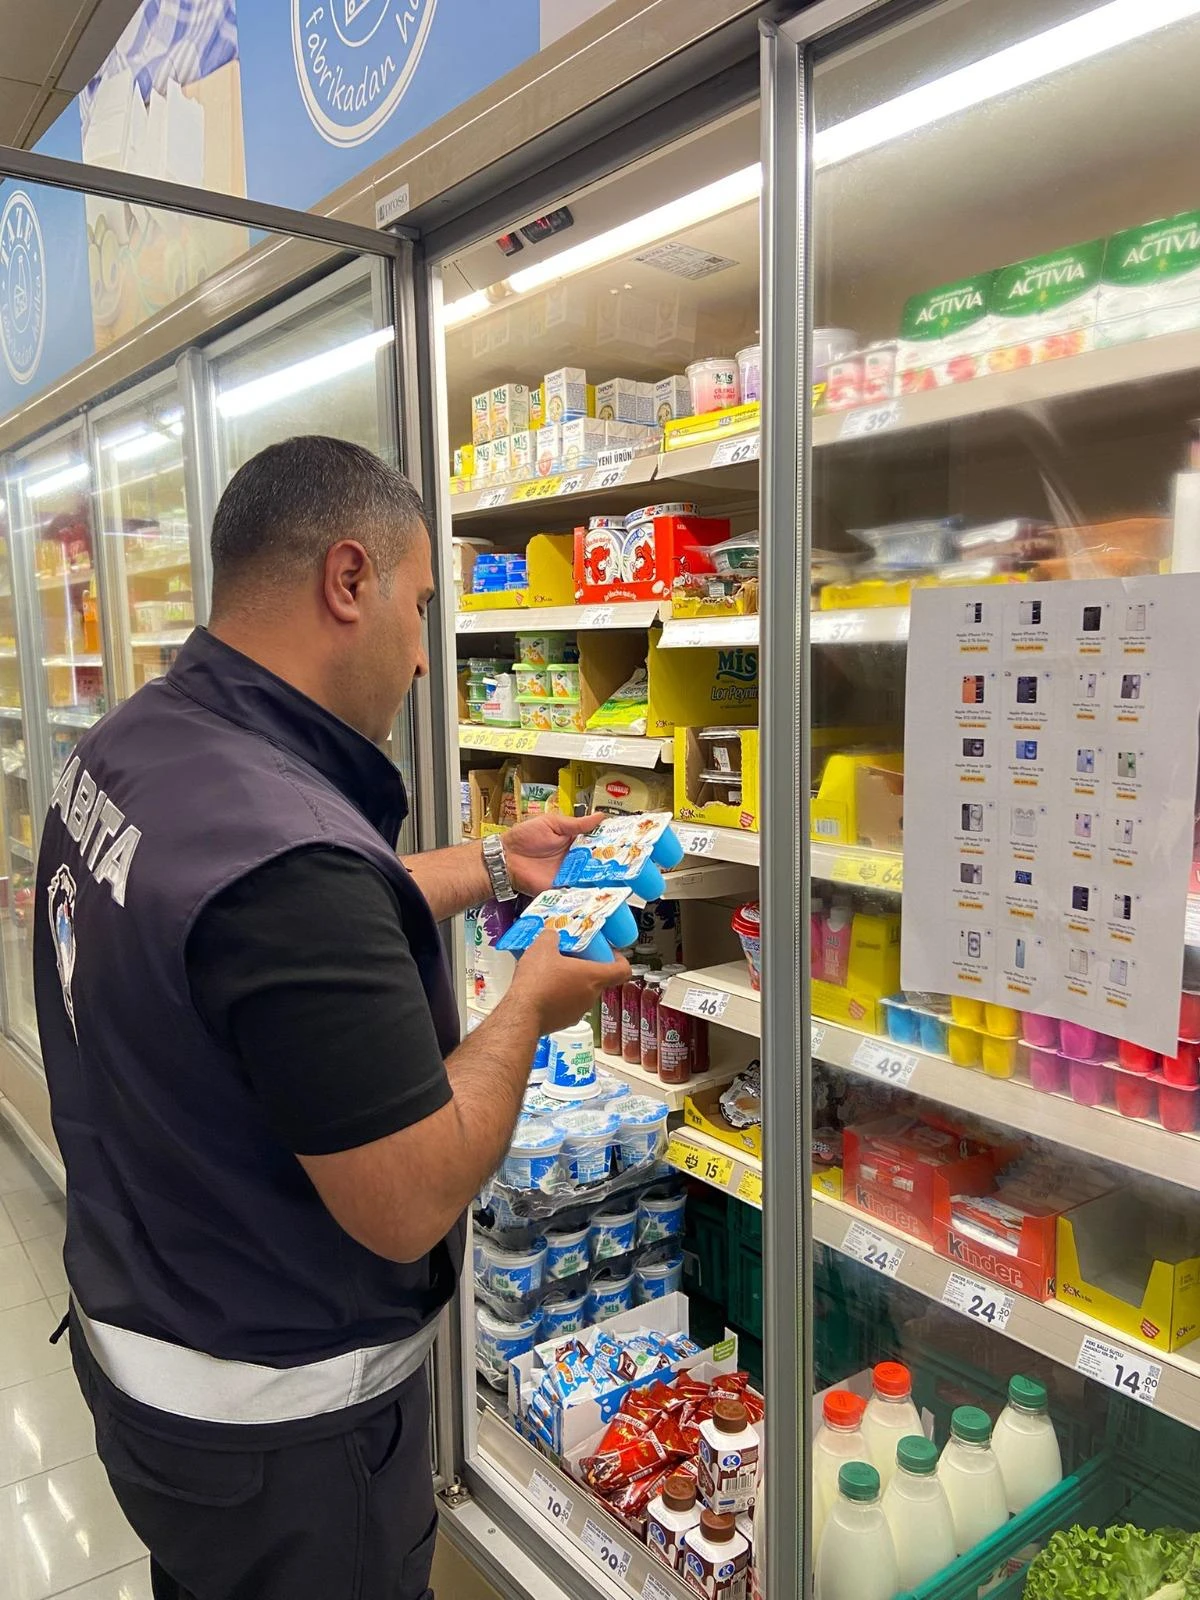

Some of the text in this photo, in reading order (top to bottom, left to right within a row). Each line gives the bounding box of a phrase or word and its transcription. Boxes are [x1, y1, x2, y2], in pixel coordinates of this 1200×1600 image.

[1008, 262, 1086, 299] ACTIVIA
[915, 291, 983, 326] ACTIVIA
[864, 411, 890, 431] 39
[598, 450, 633, 468] YENİ ÜRÜN
[731, 445, 751, 463] 62
[563, 480, 578, 494] 29
[601, 473, 619, 488] 69
[596, 744, 611, 757] 65
[51, 745, 142, 908] ABITA
[690, 836, 708, 852] 59
[698, 998, 718, 1015] 46
[876, 1057, 903, 1078] 49
[705, 1162, 719, 1179] 15
[856, 1184, 918, 1231] Kinder
[864, 1244, 889, 1270] 24
[948, 1232, 1020, 1287] Kinder
[967, 1294, 997, 1323] 24
[1115, 1363, 1140, 1394] 14
[1144, 1385, 1151, 1394] TL
[547, 1495, 561, 1518] 10
